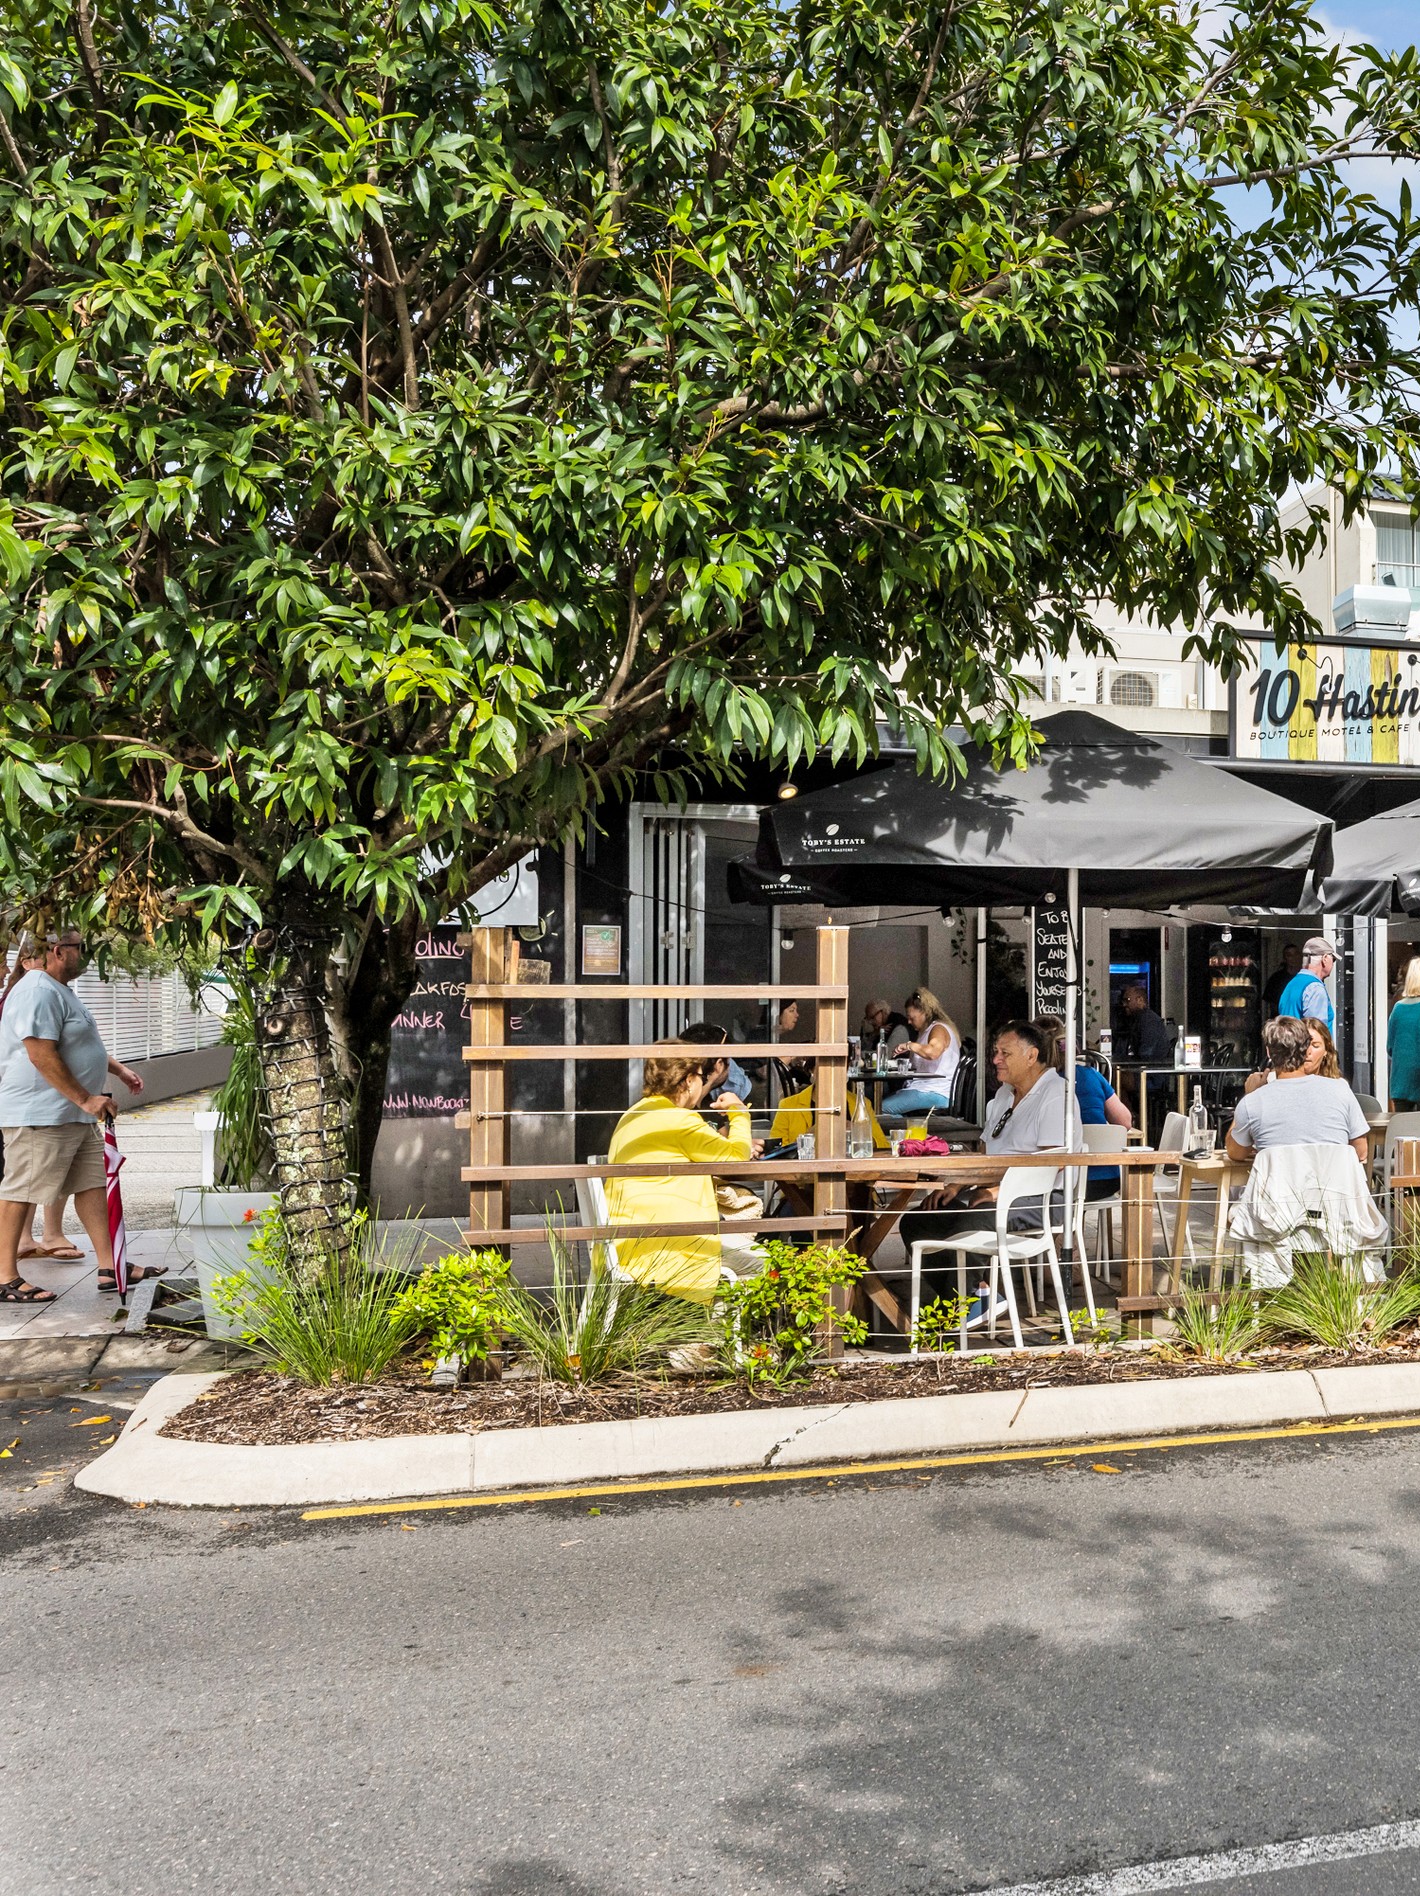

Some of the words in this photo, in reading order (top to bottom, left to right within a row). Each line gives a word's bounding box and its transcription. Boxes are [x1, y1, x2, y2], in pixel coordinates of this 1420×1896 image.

[1250, 669, 1300, 726] 10
[1250, 729, 1315, 741] BOUTIQUE
[1321, 725, 1362, 737] MOTEL
[1367, 726, 1374, 734] &
[1379, 724, 1410, 734] CAFE
[834, 838, 866, 846] ESTATE
[1036, 927, 1068, 946] SEATE
